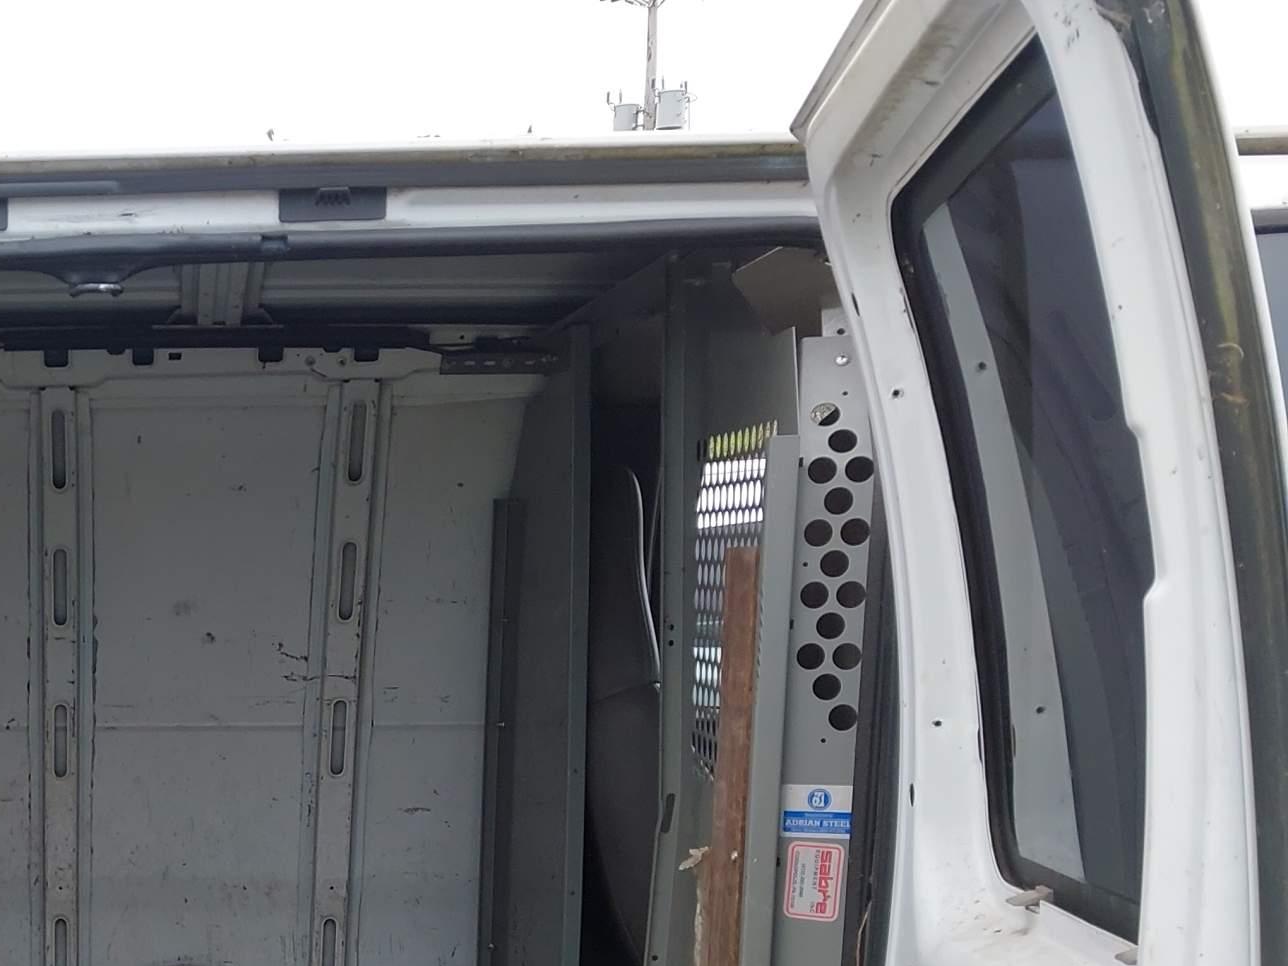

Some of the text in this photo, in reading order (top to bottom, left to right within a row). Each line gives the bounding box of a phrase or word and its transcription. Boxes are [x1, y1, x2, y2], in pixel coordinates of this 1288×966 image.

[785, 819, 821, 828] ADRIAN
[812, 849, 820, 890] EQUIPMENT
[816, 850, 833, 913] sabre
